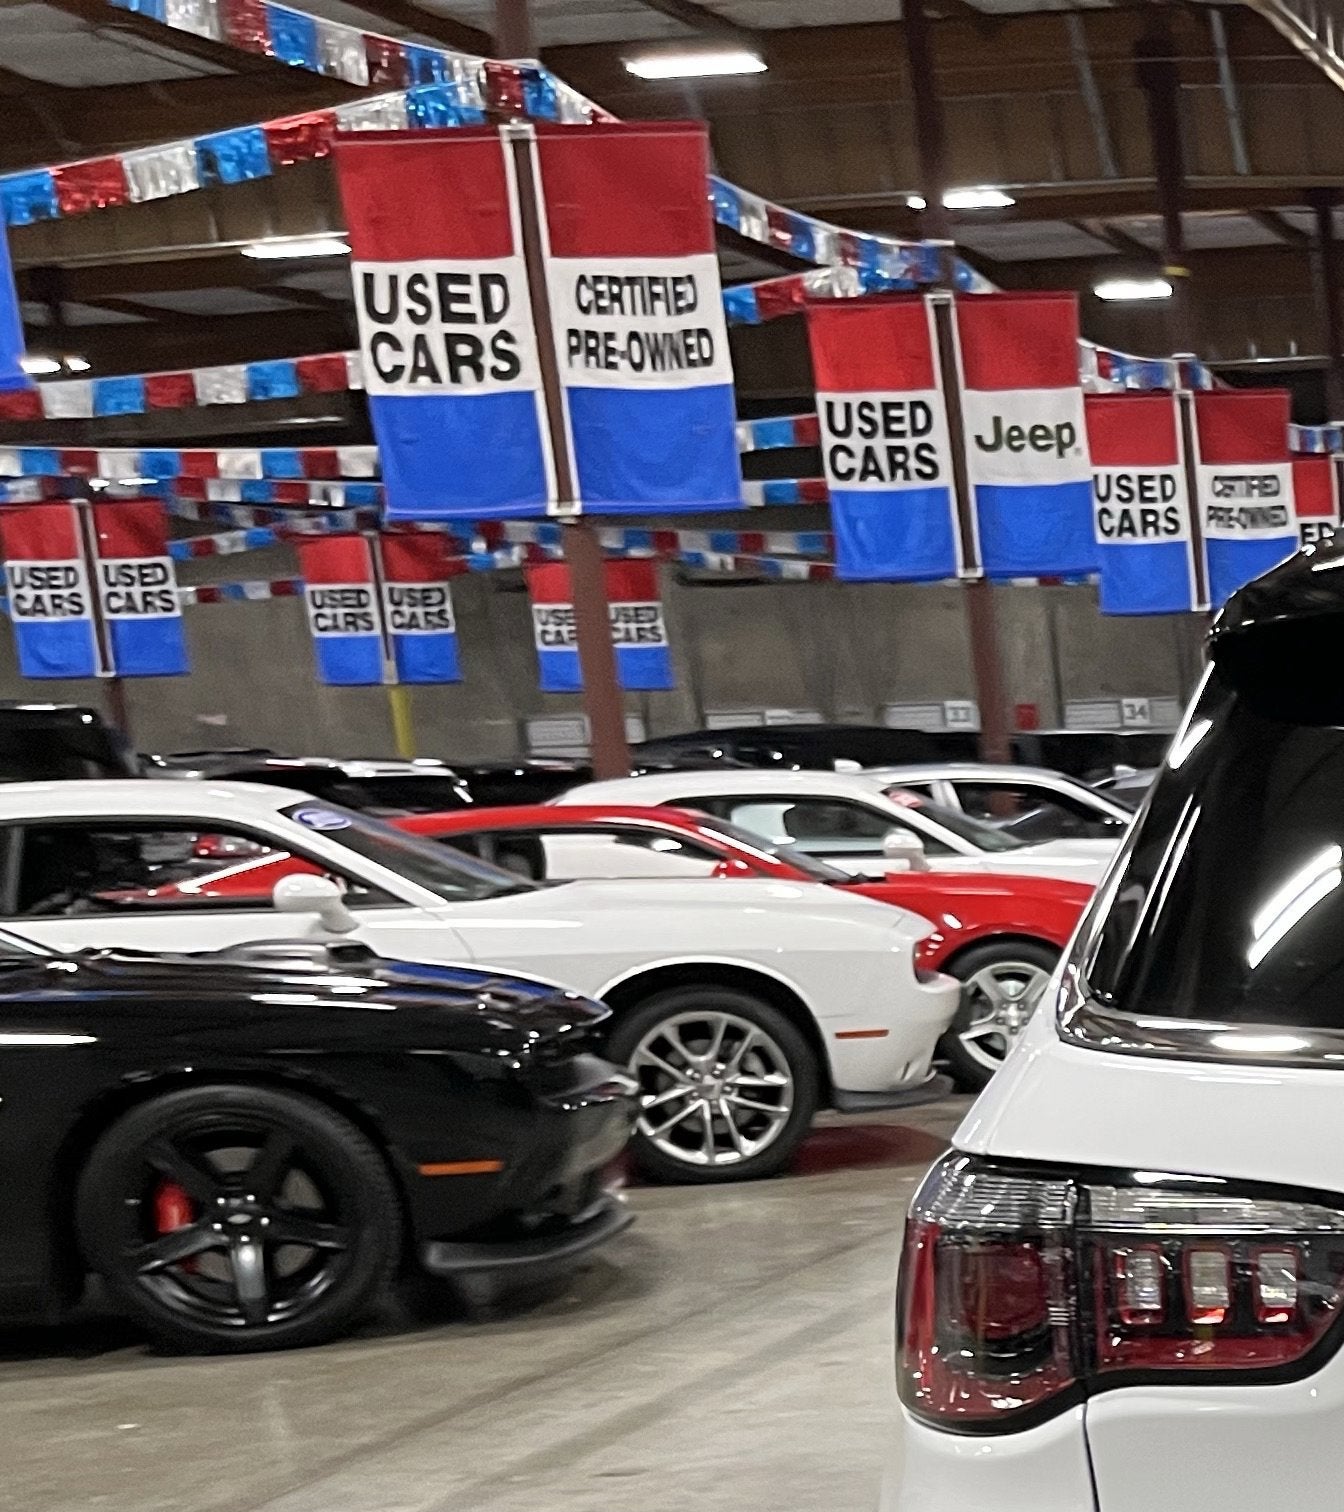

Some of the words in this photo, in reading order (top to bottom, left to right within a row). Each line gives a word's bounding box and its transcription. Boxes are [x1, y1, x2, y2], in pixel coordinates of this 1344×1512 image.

[363, 272, 510, 325] USED
[575, 274, 699, 316] CERTIFIED
[370, 329, 522, 384] CARS
[566, 327, 715, 372] PRE-OWNED
[825, 400, 934, 440] USED
[974, 415, 1076, 459] Jeep
[828, 442, 941, 482] CARS
[1093, 473, 1177, 504] USED
[1097, 506, 1181, 538] CARS
[10, 566, 79, 590] USED
[104, 562, 168, 588] USED
[13, 592, 85, 617] CARS
[105, 589, 175, 614] CARS
[310, 588, 371, 609] USED
[388, 586, 446, 607] USED
[314, 611, 375, 632] CARS
[391, 608, 450, 630] CARS
